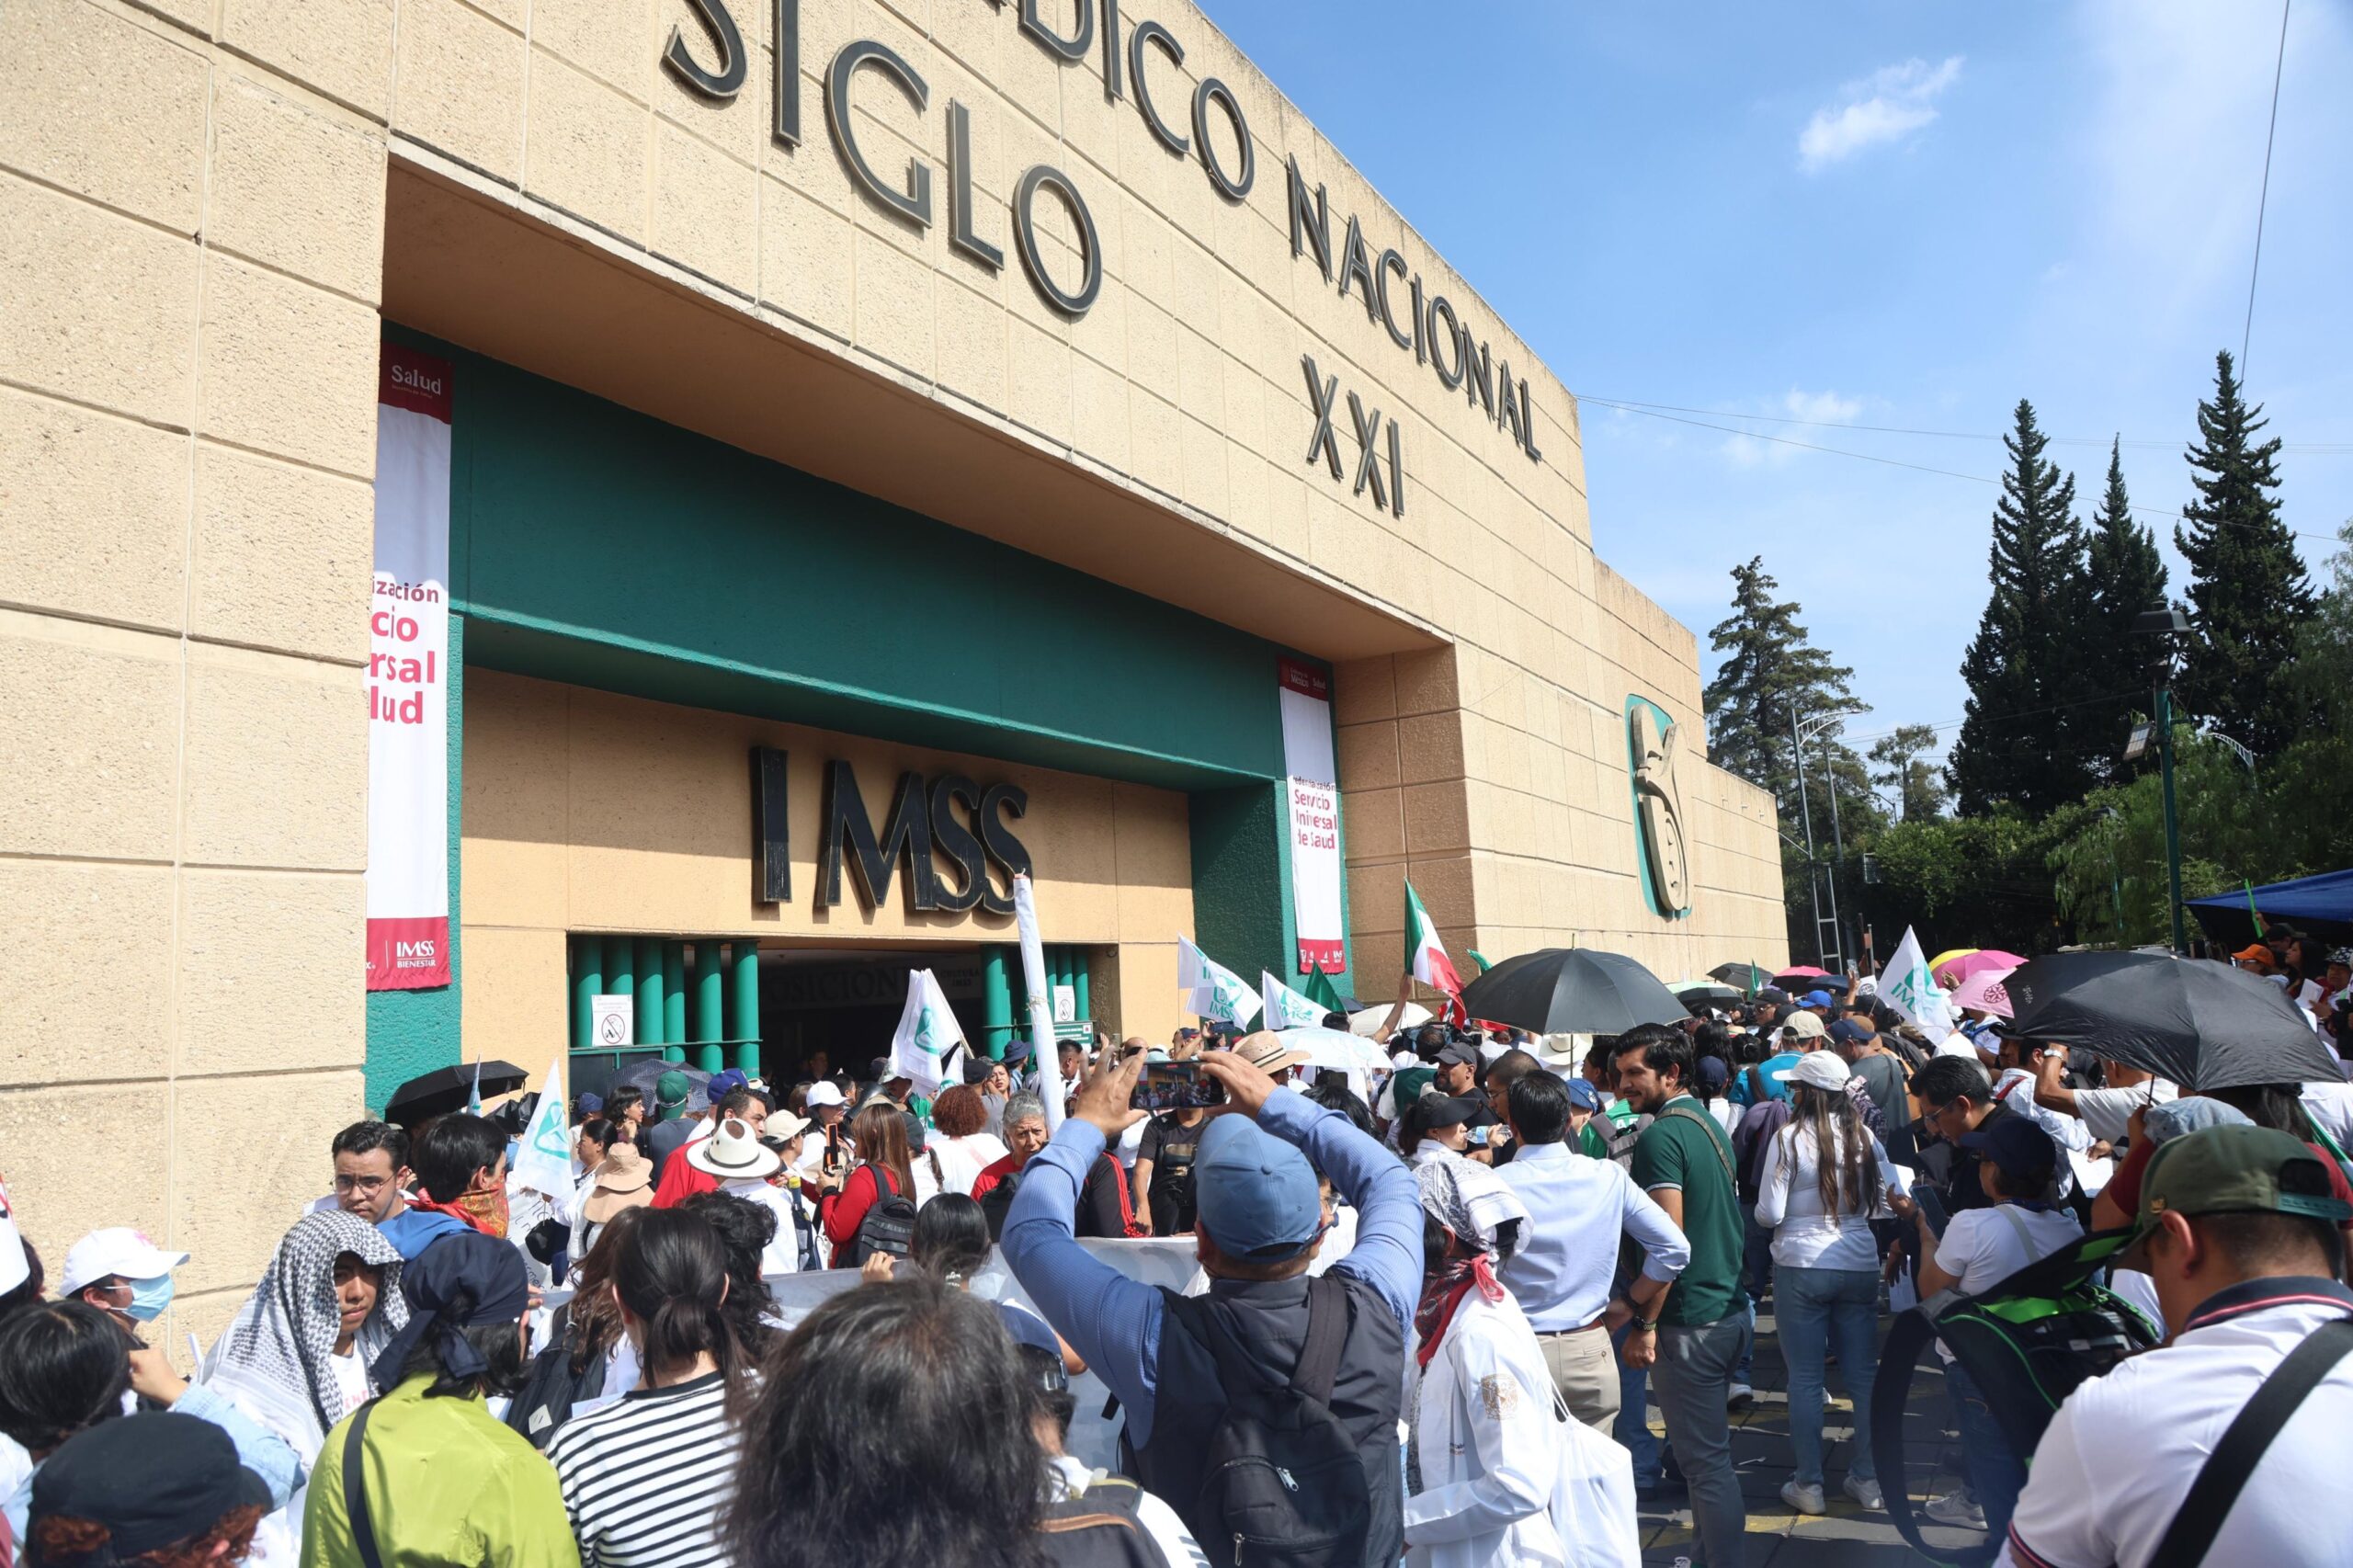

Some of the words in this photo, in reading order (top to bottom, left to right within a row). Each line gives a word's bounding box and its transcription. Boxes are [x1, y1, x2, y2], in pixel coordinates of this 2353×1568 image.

[663, 0, 1103, 313] SIGLO
[1302, 353, 1405, 517] XXI
[1289, 153, 1542, 460] NACIONAL
[392, 364, 441, 395] Salud
[752, 746, 1032, 915] IMSS
[396, 940, 435, 957] IMSS
[397, 960, 436, 968] BIENESTAR
[1209, 1001, 1235, 1021] IMSS
